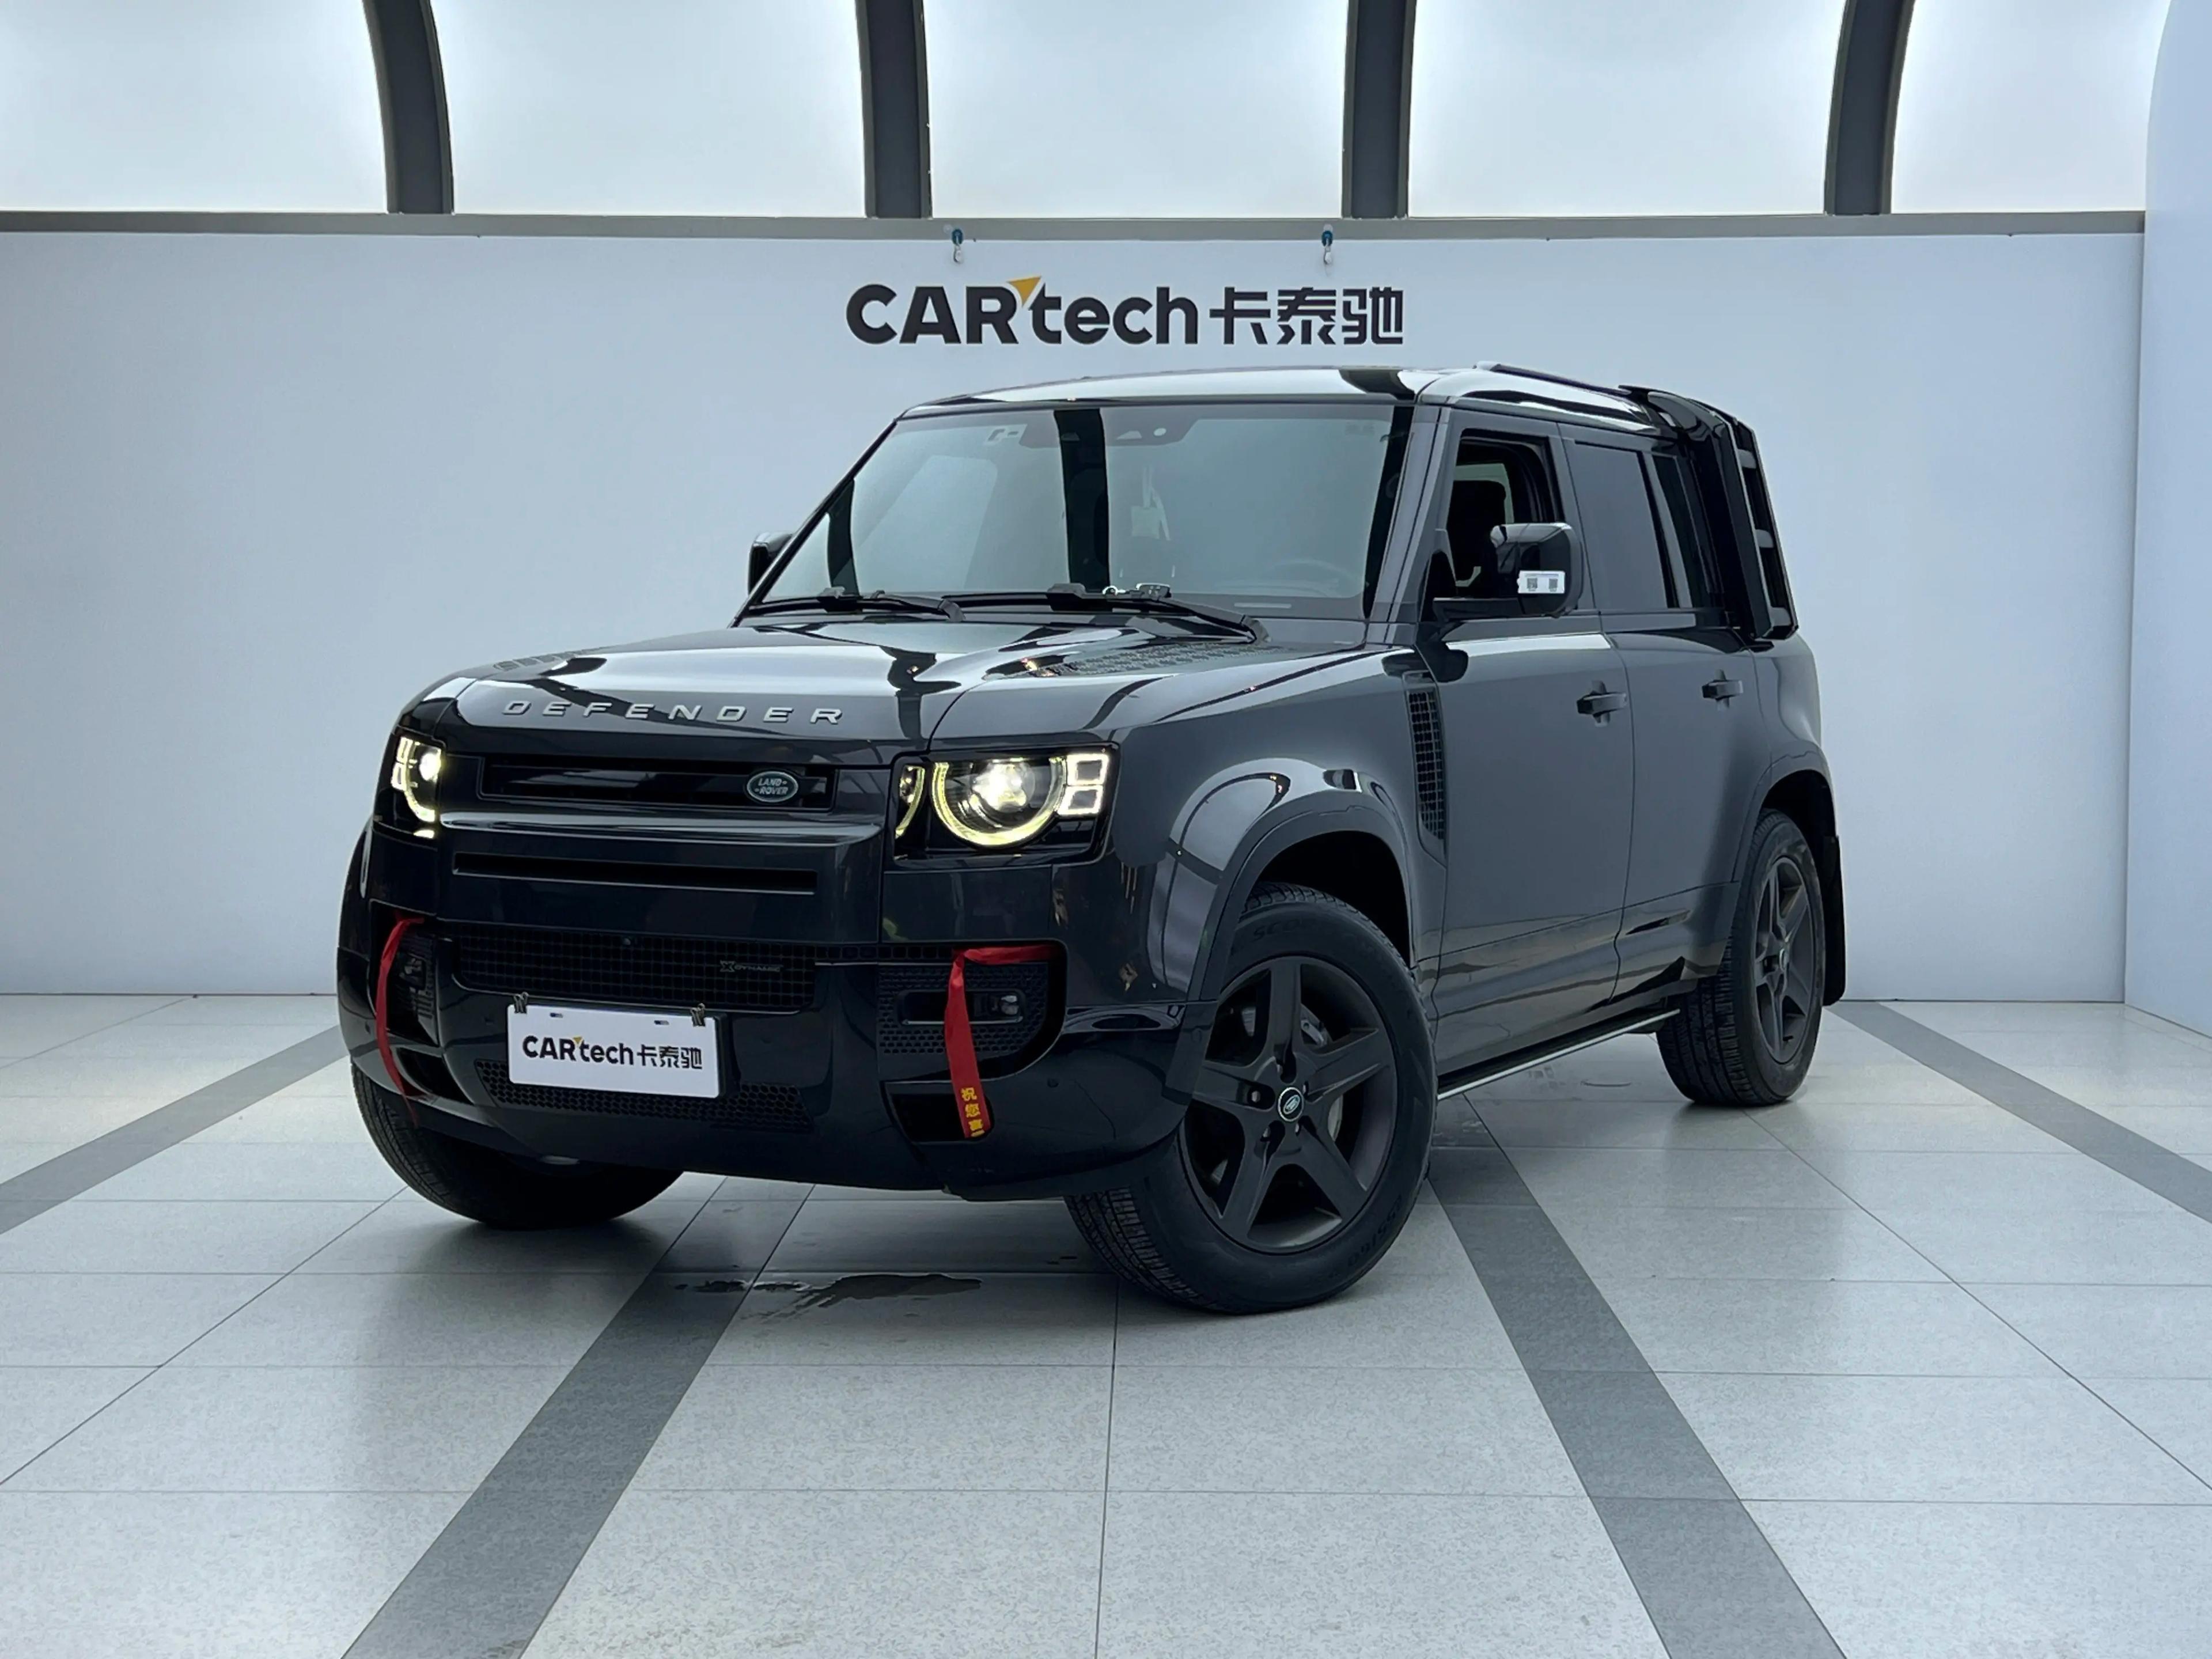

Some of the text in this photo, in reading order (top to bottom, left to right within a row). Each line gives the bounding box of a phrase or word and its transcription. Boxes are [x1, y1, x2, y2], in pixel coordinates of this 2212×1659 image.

[1209, 286, 1403, 345] 卡泰驰
[502, 700, 843, 725] DEFENDER
[757, 778, 782, 787] LAND
[759, 786, 789, 795] ROVER
[637, 1044, 703, 1070] 卡泰驰
